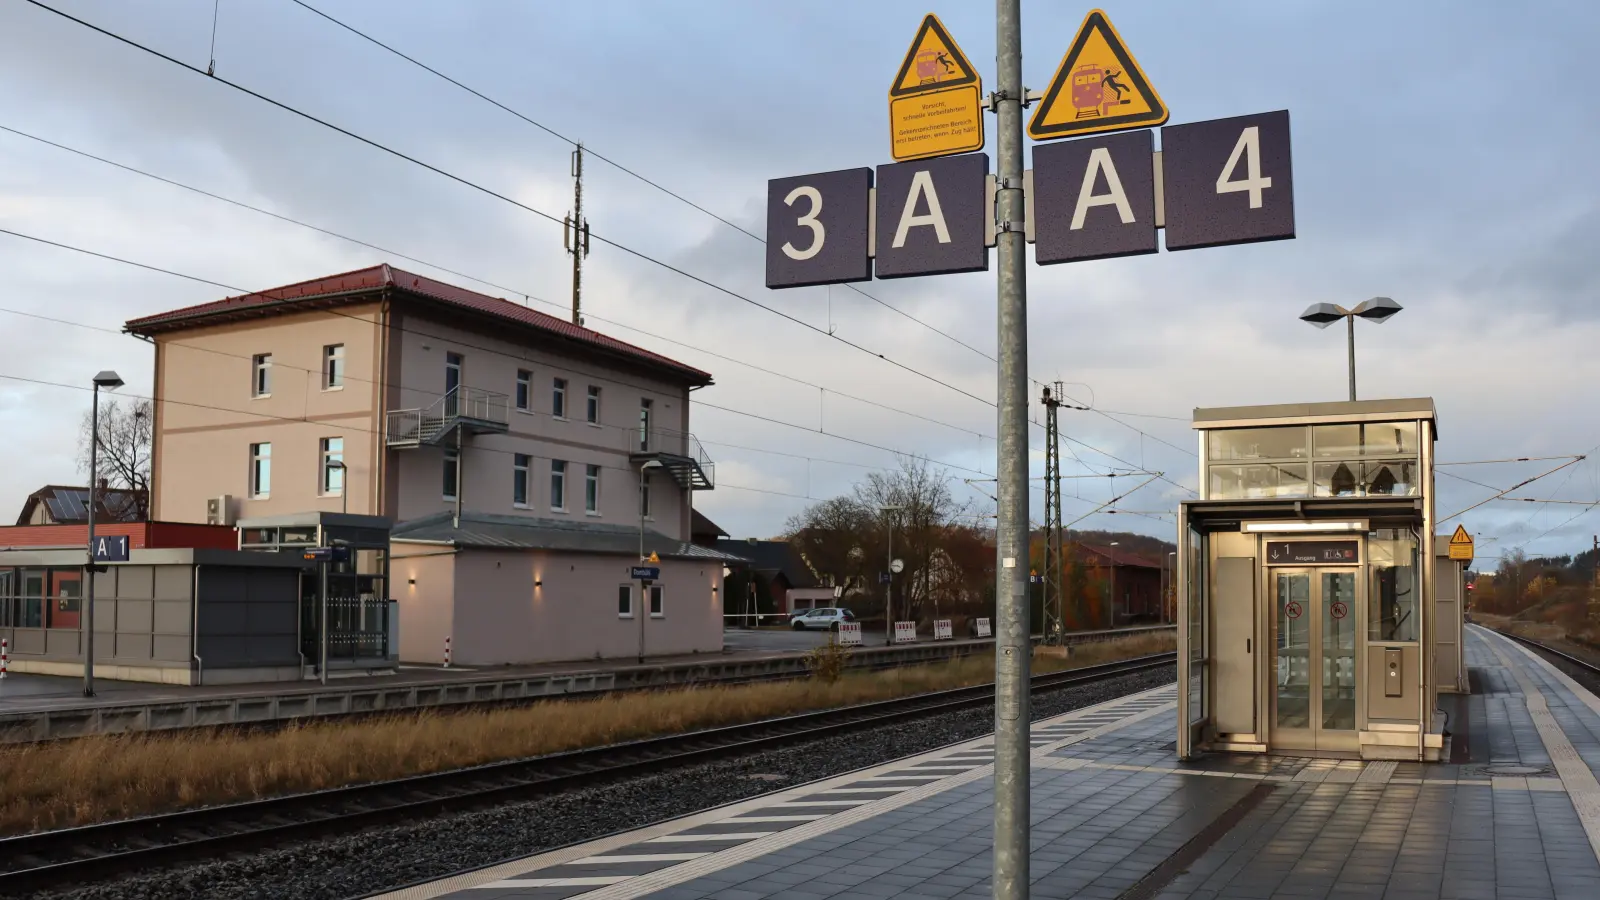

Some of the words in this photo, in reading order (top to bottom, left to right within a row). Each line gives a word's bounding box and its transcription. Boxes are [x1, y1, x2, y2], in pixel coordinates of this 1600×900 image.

[903, 113, 926, 121] schnelle
[1070, 147, 1136, 231] A
[1215, 126, 1272, 209] 4
[781, 185, 826, 261] 3
[892, 170, 952, 249] A
[97, 537, 107, 556] A
[119, 537, 125, 556] 1
[1284, 544, 1290, 555] 1
[1030, 575, 1036, 583] B
